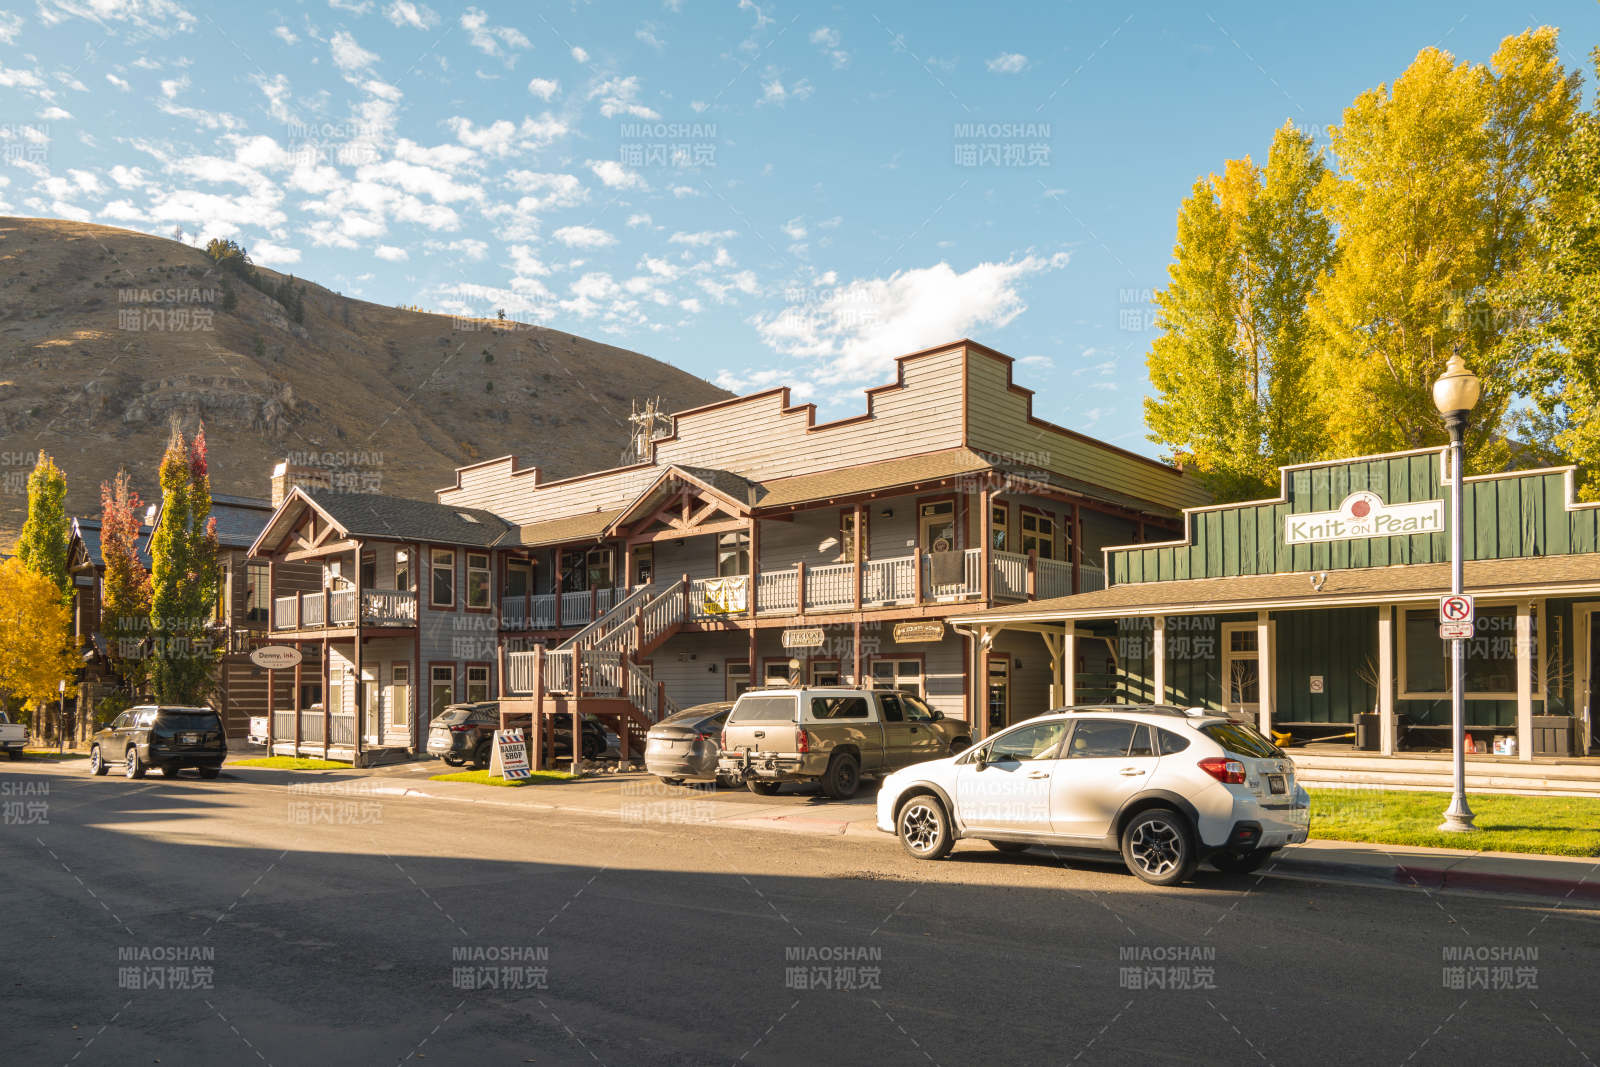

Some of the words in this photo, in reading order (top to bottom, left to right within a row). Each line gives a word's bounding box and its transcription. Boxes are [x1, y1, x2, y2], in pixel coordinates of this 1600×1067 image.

[1292, 519, 1345, 540] Knit
[1351, 525, 1370, 535] ON
[1375, 509, 1438, 533] Pearl
[501, 744, 524, 752] BARBER
